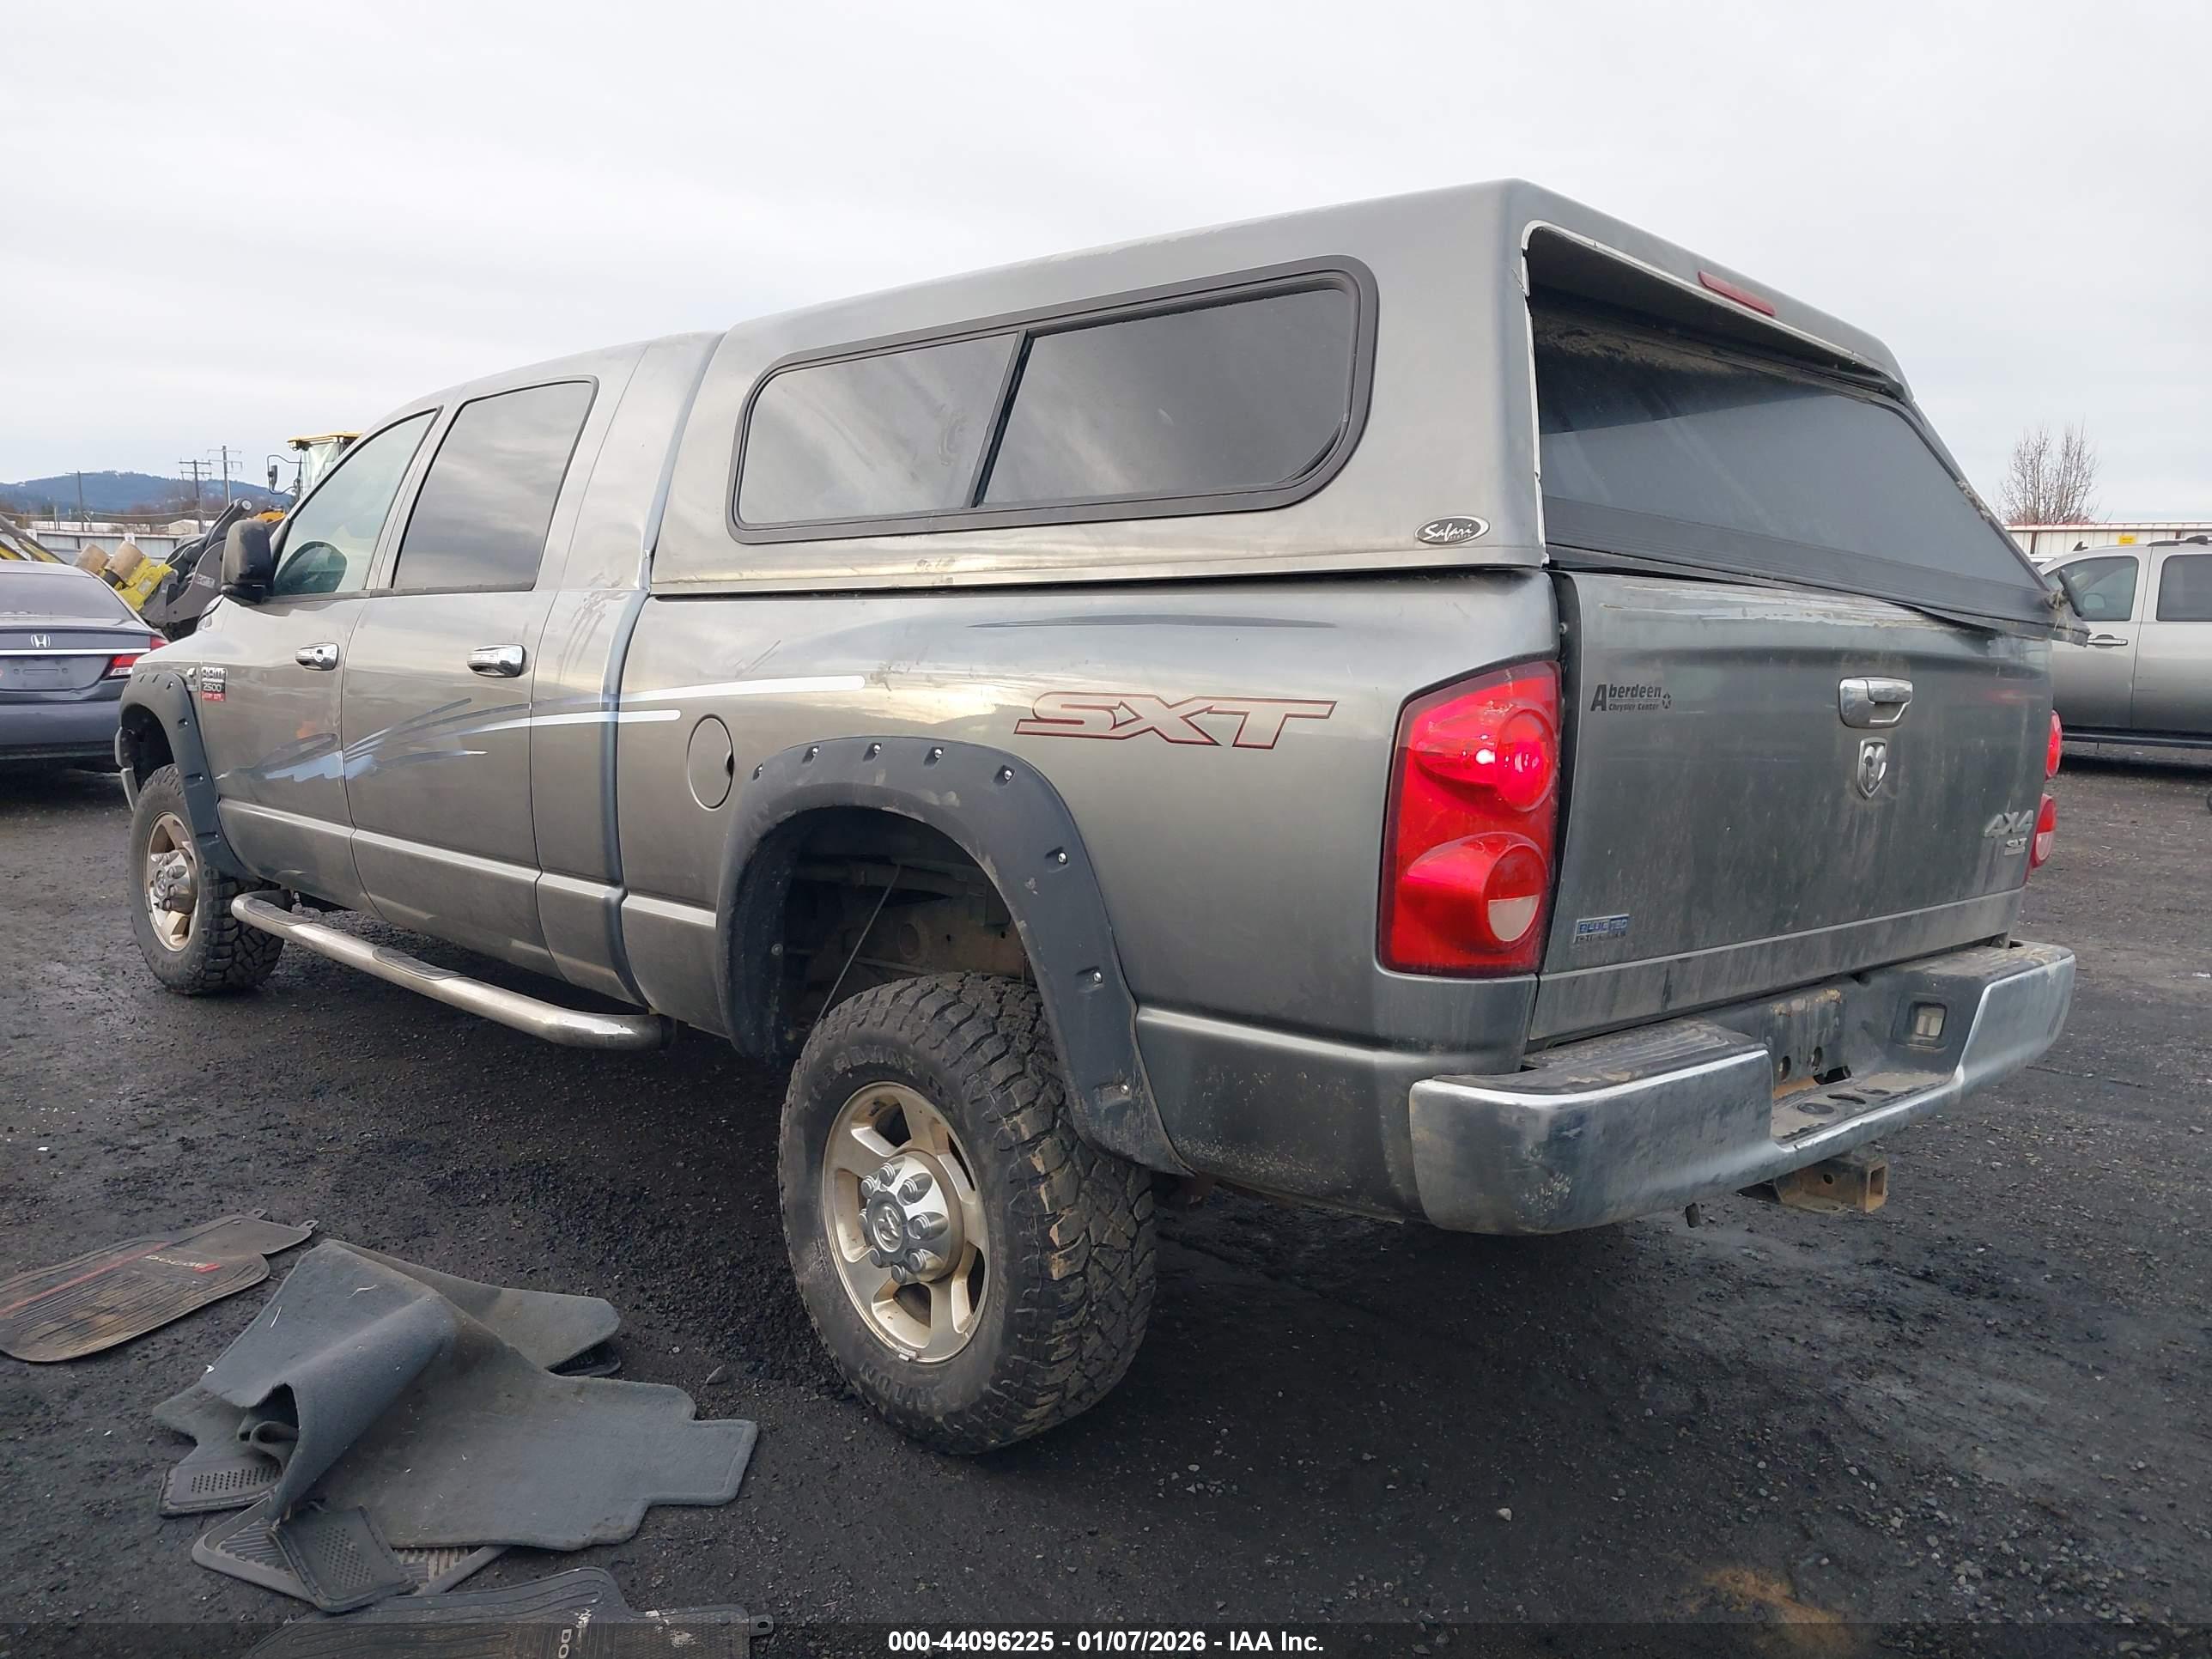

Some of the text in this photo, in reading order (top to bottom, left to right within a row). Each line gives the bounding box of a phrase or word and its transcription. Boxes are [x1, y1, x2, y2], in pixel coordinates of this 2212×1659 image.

[1422, 523, 1474, 542] Safari
[203, 682, 222, 692] 2500
[1590, 684, 1662, 712] Aberdeen
[1013, 691, 1337, 750] SXT
